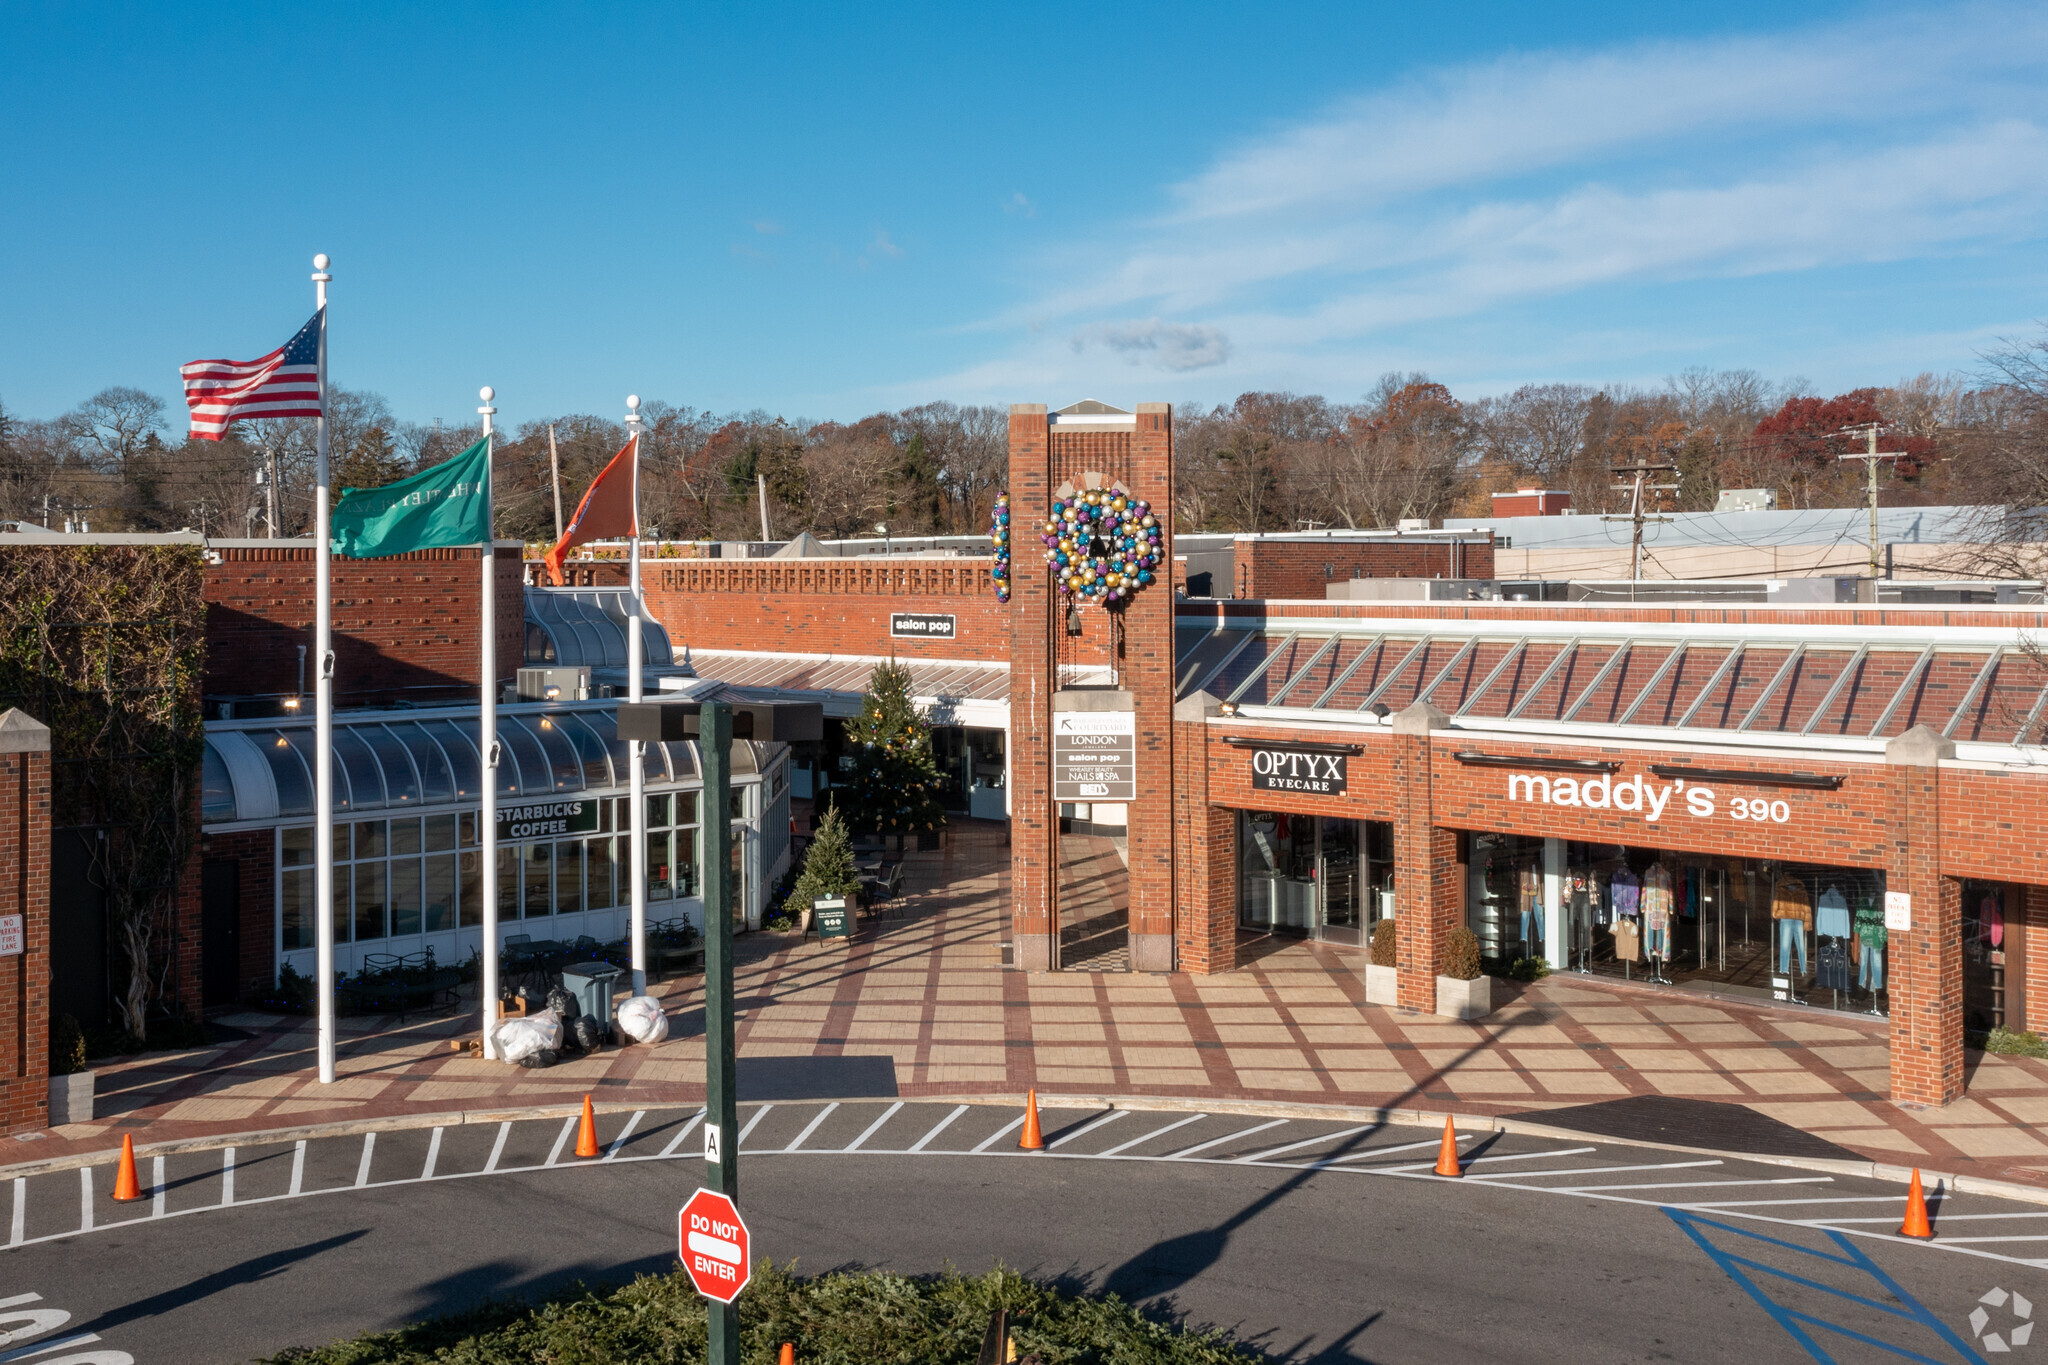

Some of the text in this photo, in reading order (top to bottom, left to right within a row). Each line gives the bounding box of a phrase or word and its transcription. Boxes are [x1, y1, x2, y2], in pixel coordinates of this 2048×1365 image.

[895, 619, 951, 633] salon pop
[1071, 735, 1117, 745] LONDON
[1068, 753, 1121, 763] salon pop
[1253, 750, 1343, 780] OPTYX
[1104, 772, 1120, 781] SPA
[1268, 777, 1330, 792] EYECARE
[1508, 772, 1791, 823] maddy's 390
[496, 801, 583, 823] STARBUCKS
[510, 819, 567, 837] COFFEE
[3, 919, 14, 927] NO
[0, 926, 20, 936] ARKING
[2, 935, 17, 943] FIRE
[1, 942, 18, 951] LANE
[707, 1132, 718, 1155] A
[691, 1213, 739, 1242] DO NOT
[694, 1255, 737, 1283] ENTER
